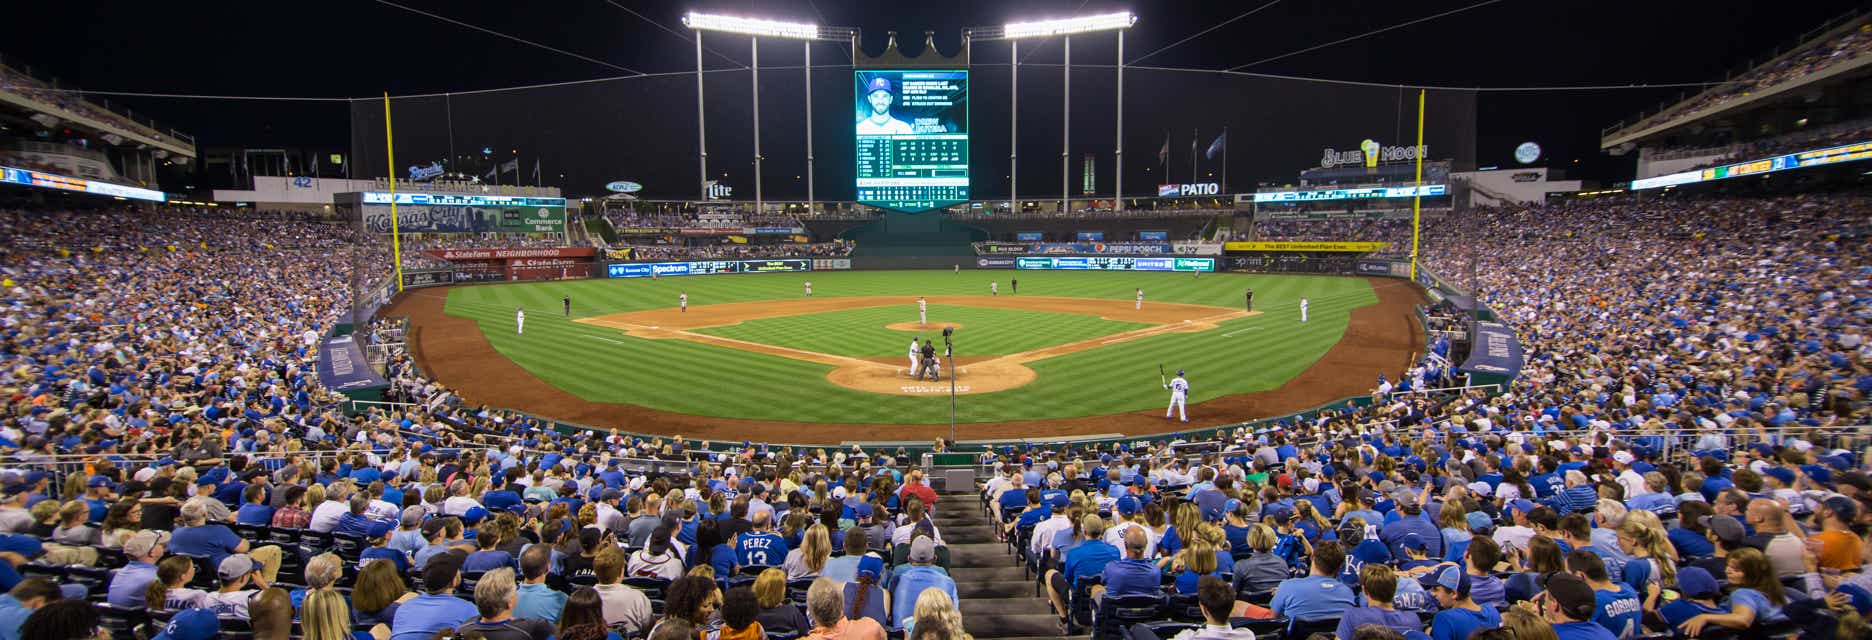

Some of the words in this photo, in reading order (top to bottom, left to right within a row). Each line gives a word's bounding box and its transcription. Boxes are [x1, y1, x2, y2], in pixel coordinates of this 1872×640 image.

[1321, 148, 1362, 168] BLUE
[1381, 144, 1428, 161] MOON
[294, 176, 312, 188] 42
[706, 180, 732, 199] Lite
[1181, 183, 1219, 196] PATIO
[496, 249, 560, 258] NEIGHBORHOOD
[1133, 245, 1162, 253] PORCH
[652, 264, 688, 274] Spectrum
[1137, 260, 1164, 268] UNITED
[743, 538, 772, 550] PEREZ
[747, 551, 767, 566] 13
